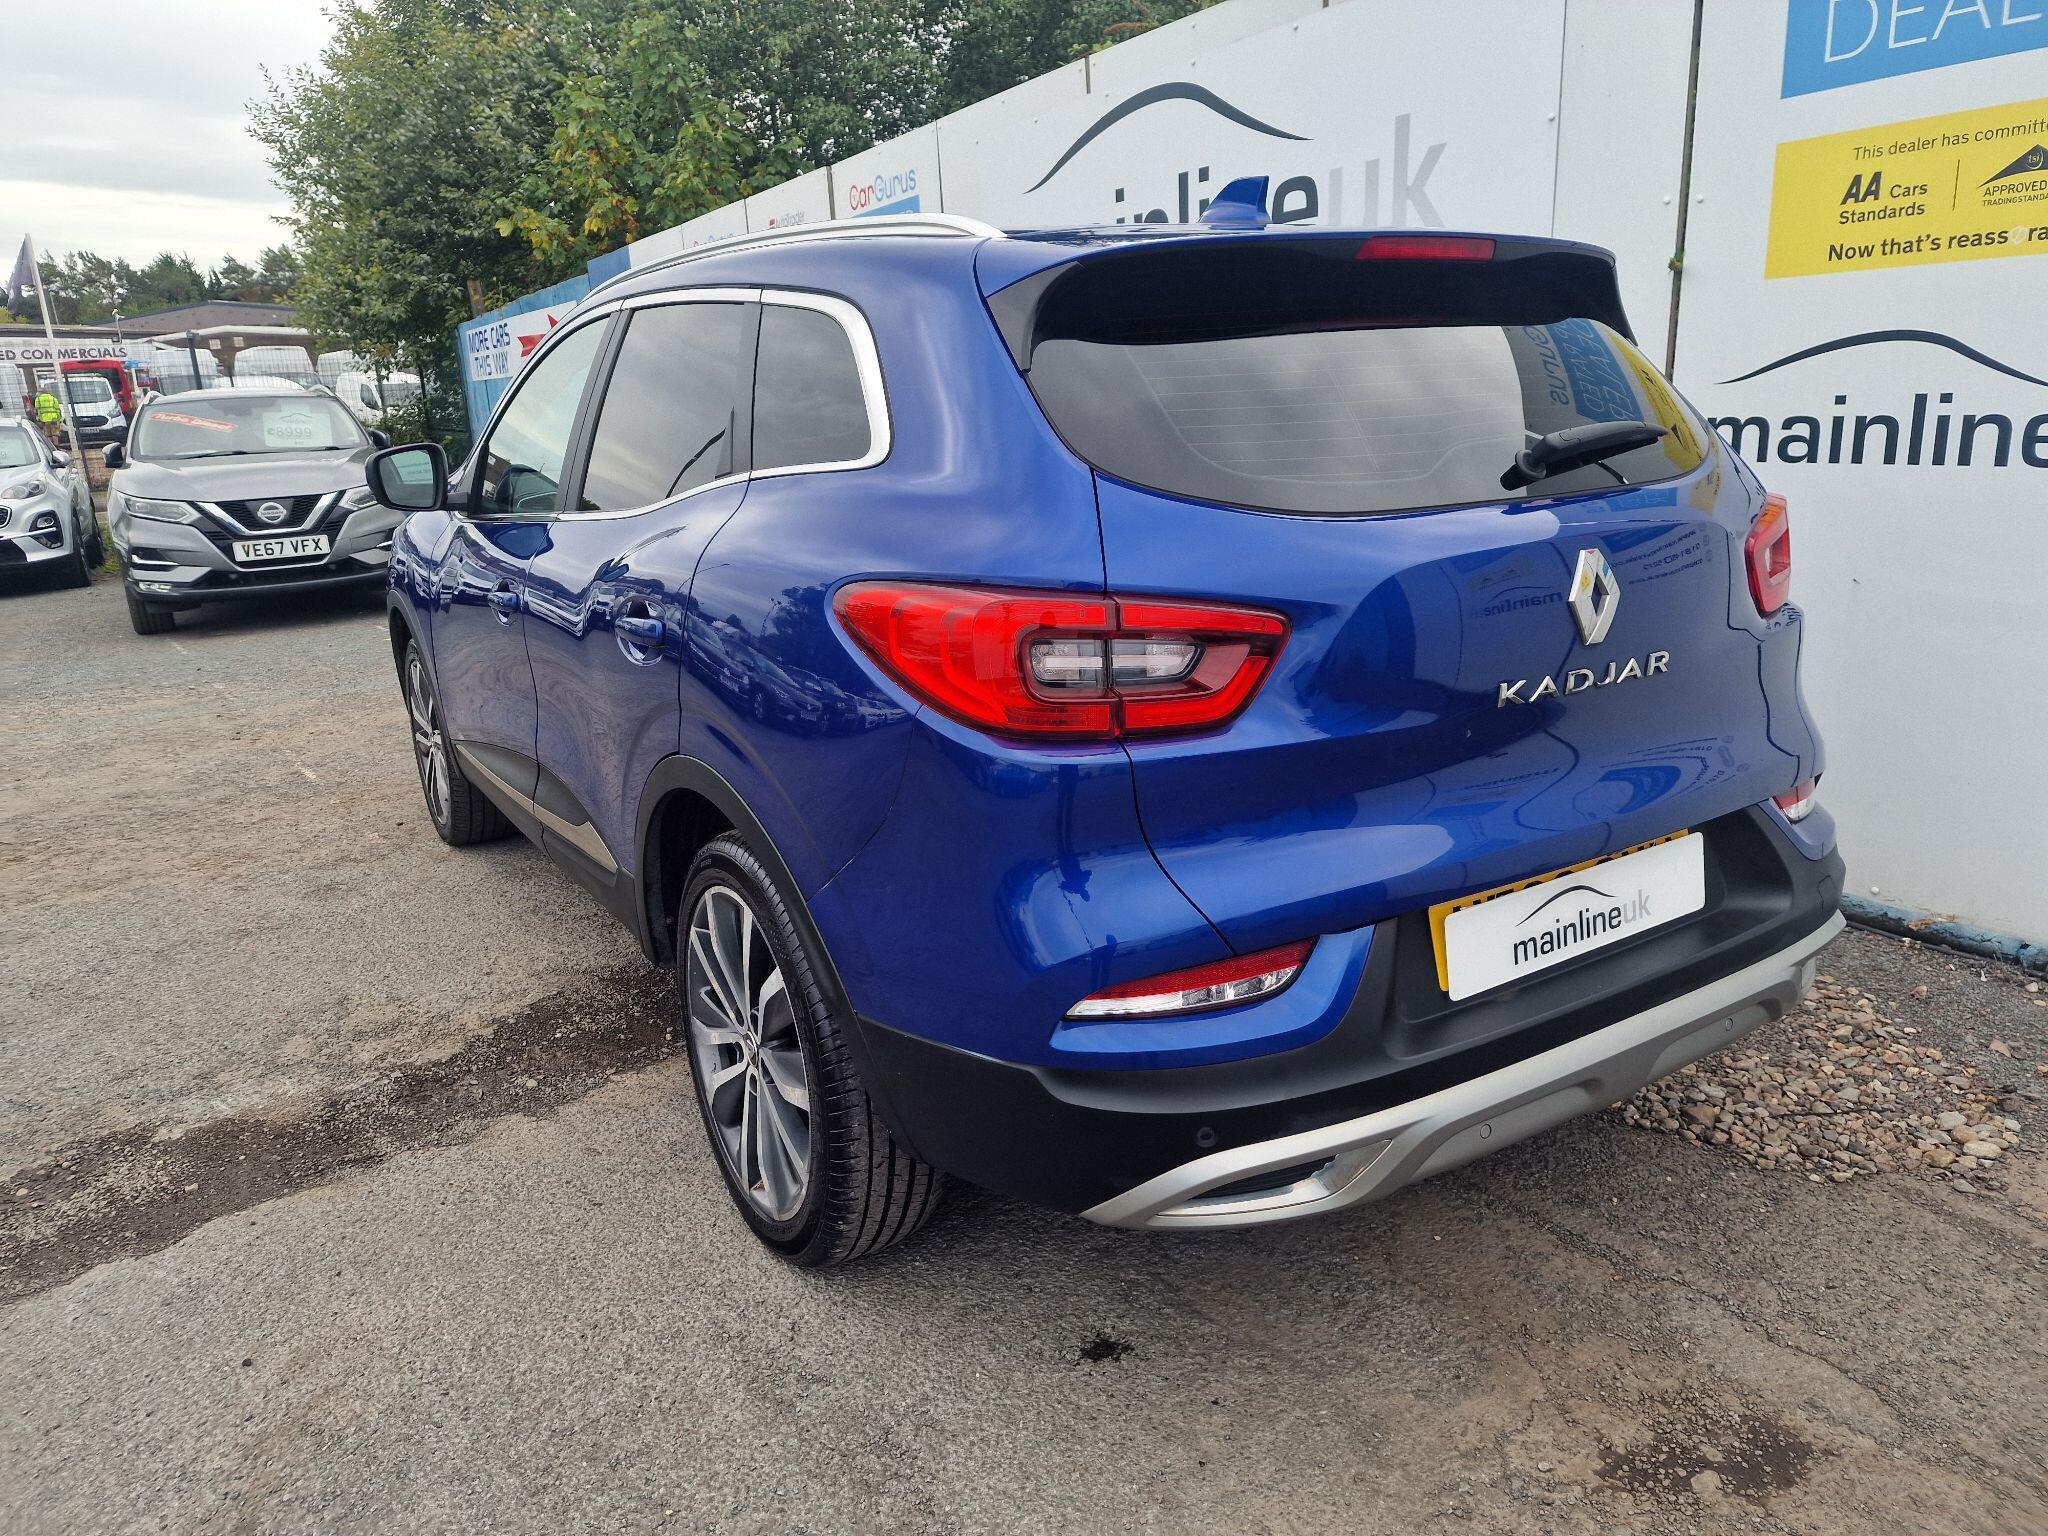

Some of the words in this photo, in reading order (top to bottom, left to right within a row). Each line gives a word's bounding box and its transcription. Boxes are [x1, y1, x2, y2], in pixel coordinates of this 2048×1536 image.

[1853, 144, 1884, 161] This
[1888, 136, 1938, 155] dealer
[1941, 132, 1970, 148] has
[849, 168, 918, 211] CarGurus
[1840, 171, 1883, 206] AA
[1890, 182, 1929, 199] Cars
[1983, 179, 2048, 197] APPROVED
[1838, 202, 1926, 225] Standards
[1828, 243, 1876, 262] Now
[1881, 233, 1942, 256] that's
[468, 328, 490, 353] MORE
[490, 322, 511, 349] CARS
[474, 354, 493, 377] THIS
[492, 350, 509, 375] WAY
[241, 541, 284, 558] VE67
[290, 538, 323, 554] VFX
[1498, 650, 1671, 708] KADJAR
[1512, 889, 1653, 966] mainlineuk
